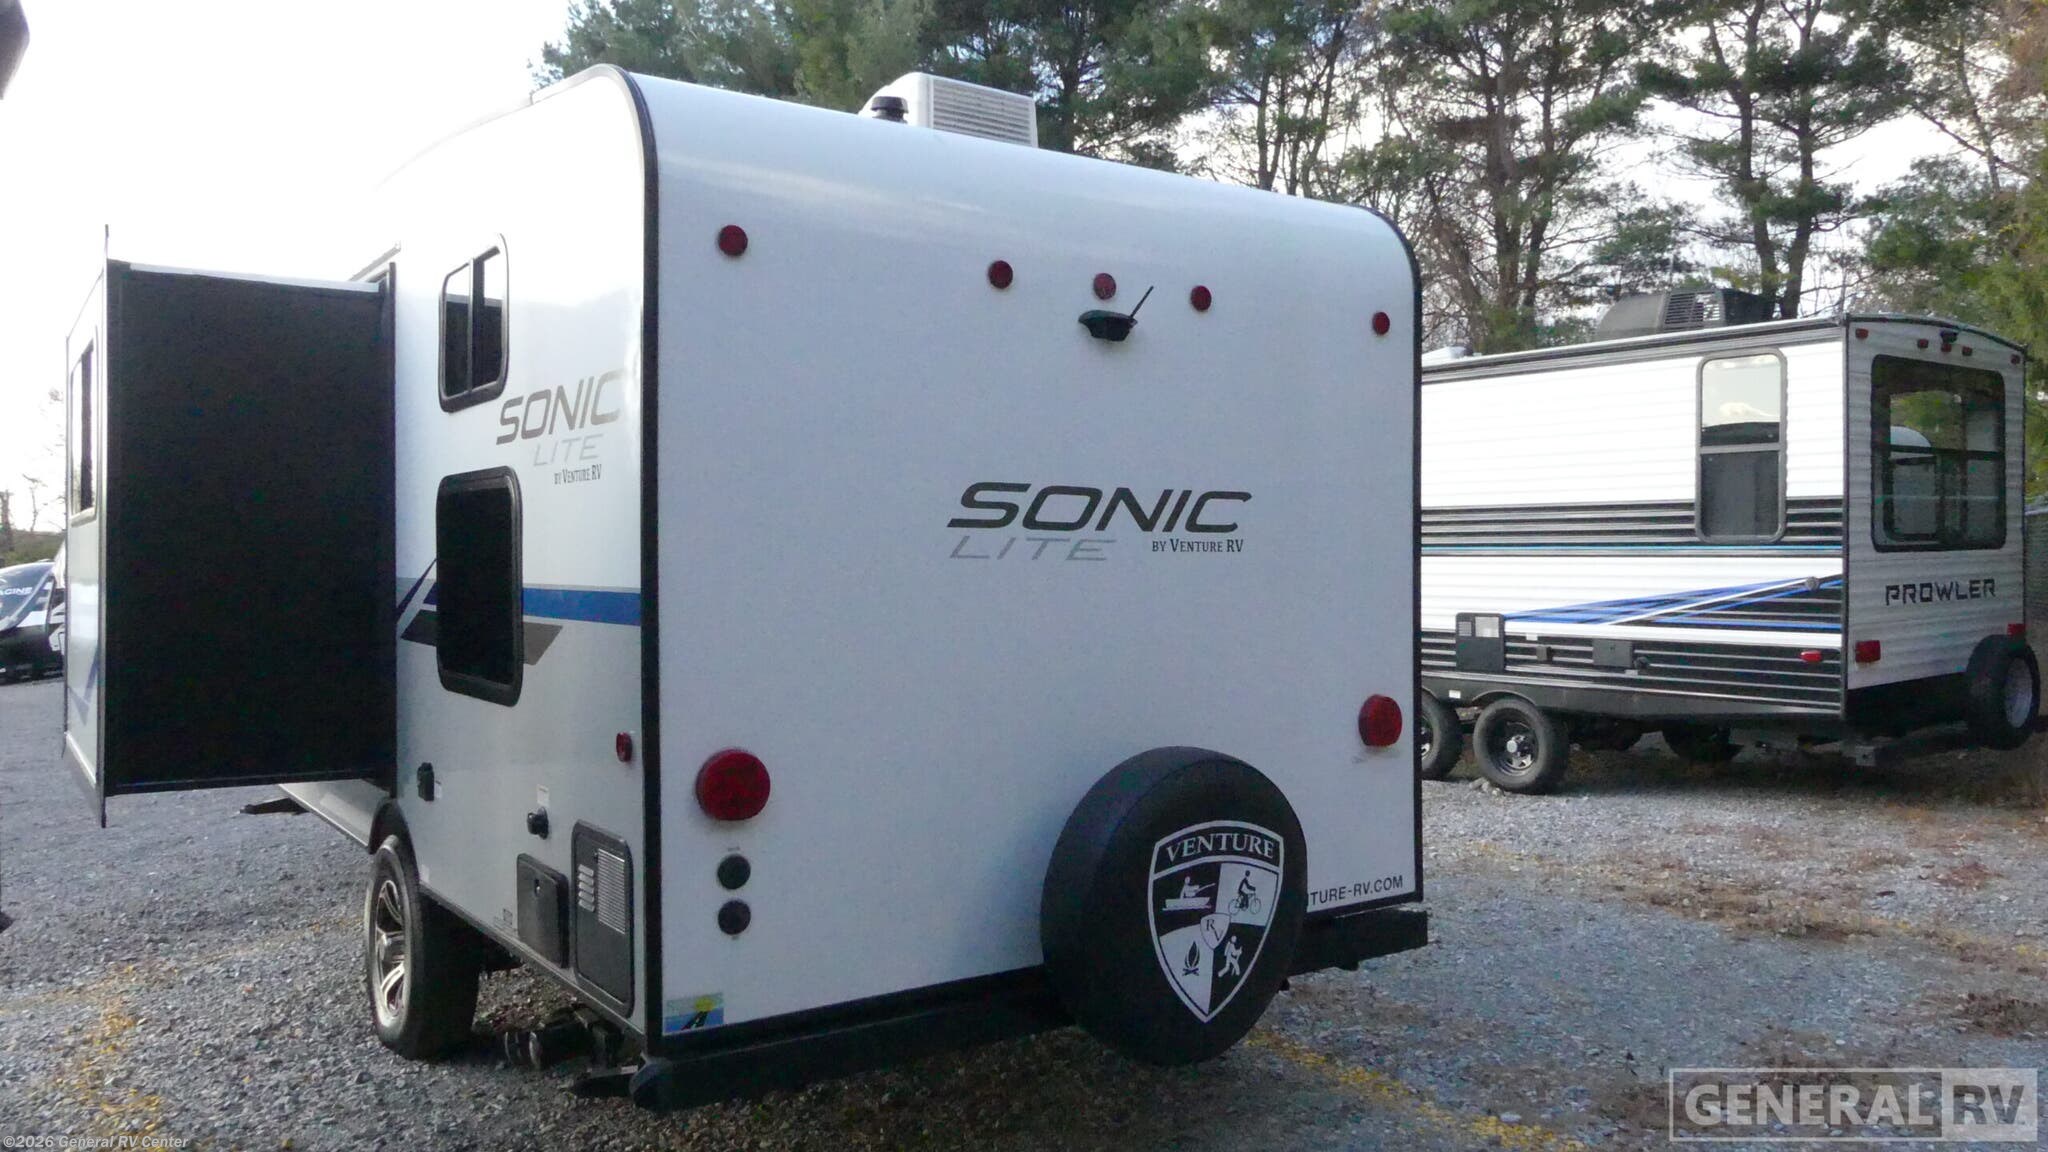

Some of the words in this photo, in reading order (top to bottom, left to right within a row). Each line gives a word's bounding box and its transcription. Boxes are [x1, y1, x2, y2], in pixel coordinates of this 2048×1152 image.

[496, 370, 625, 445] SONIC
[533, 434, 604, 467] LITE
[591, 464, 602, 481] RV
[947, 482, 1253, 533] SONIC
[949, 535, 1117, 561] LITE
[1169, 538, 1223, 553] VENTURE
[1226, 539, 1244, 553] RV
[1885, 578, 1996, 606] PROWLER
[1166, 832, 1276, 863] VENTURE
[1308, 875, 1404, 906] TURE-RV.COM
